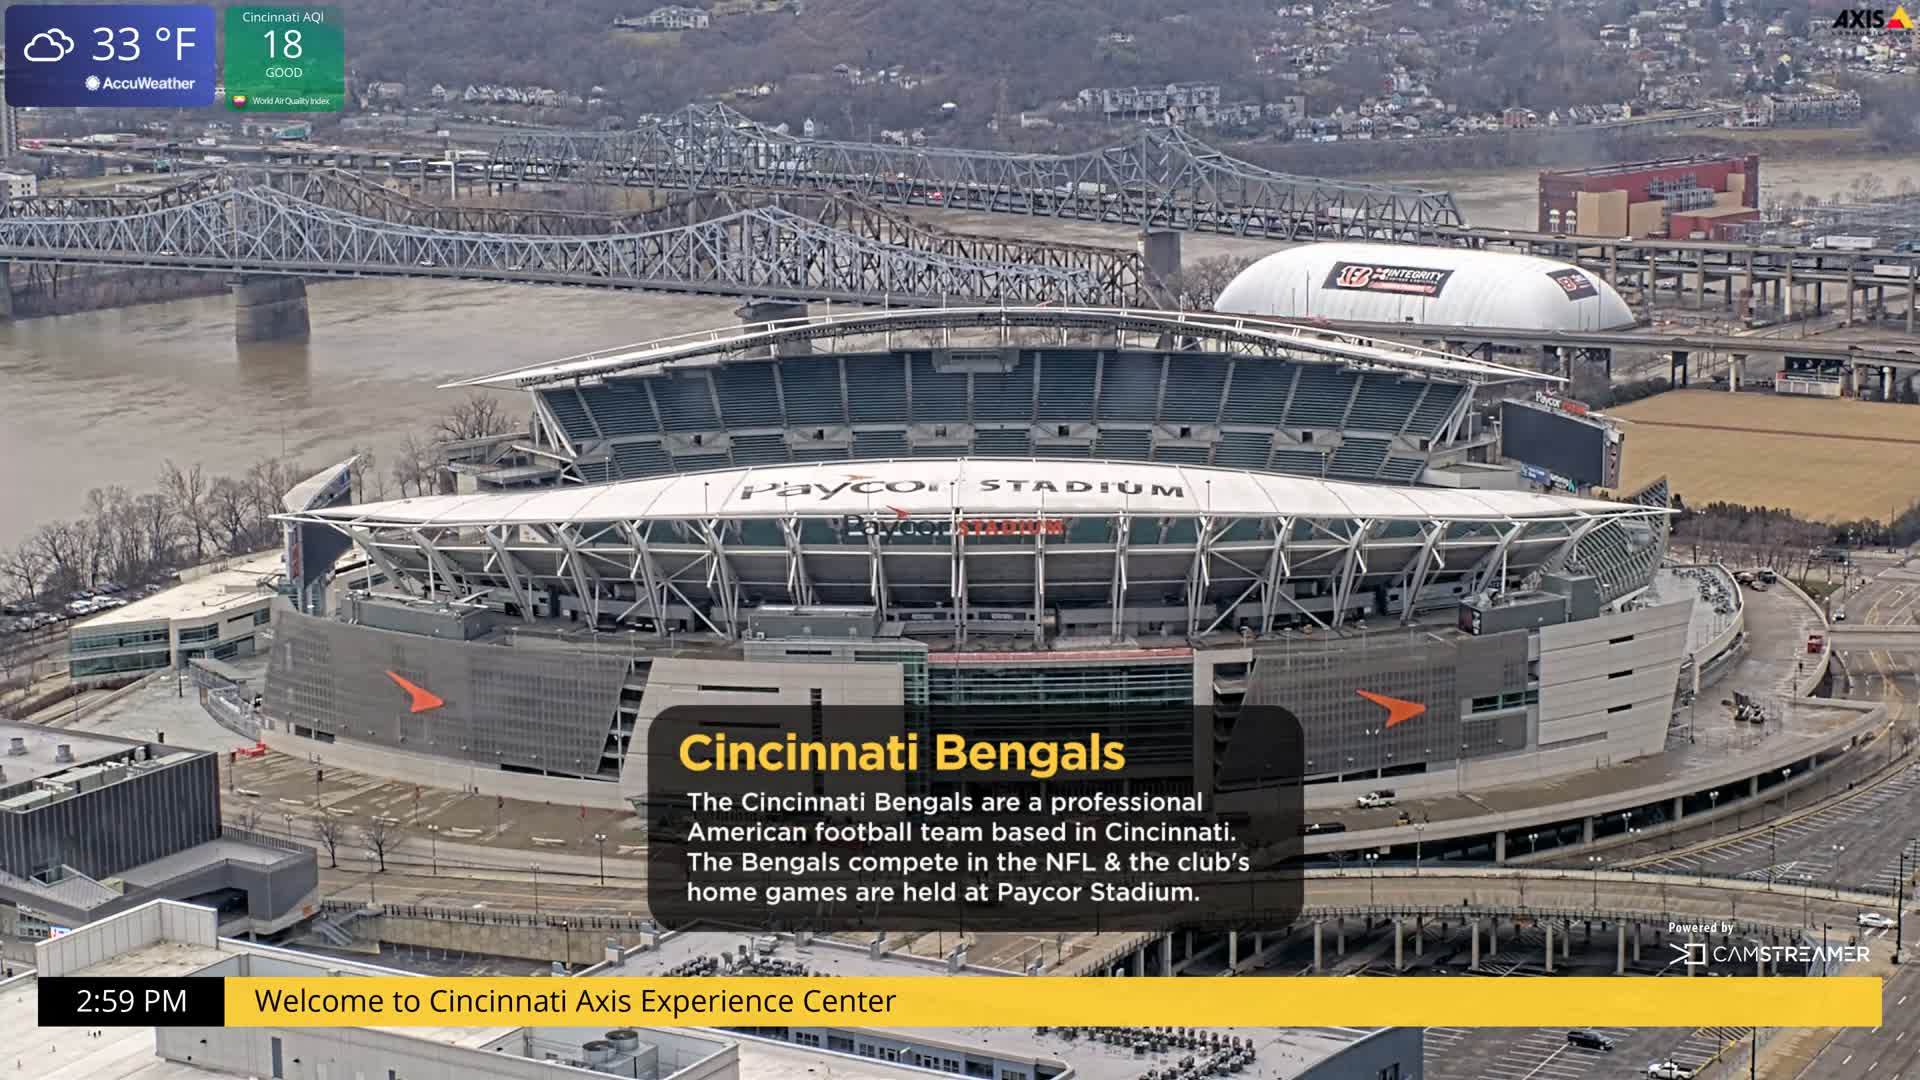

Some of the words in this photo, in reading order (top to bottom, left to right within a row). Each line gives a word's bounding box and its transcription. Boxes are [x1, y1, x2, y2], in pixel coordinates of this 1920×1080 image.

[1387, 268, 1445, 281] INTEGRITY
[1535, 391, 1561, 409] Paycor
[979, 479, 1185, 498] STADIUM
[843, 514, 953, 541] Paycor
[958, 519, 1064, 538] STADIUM
